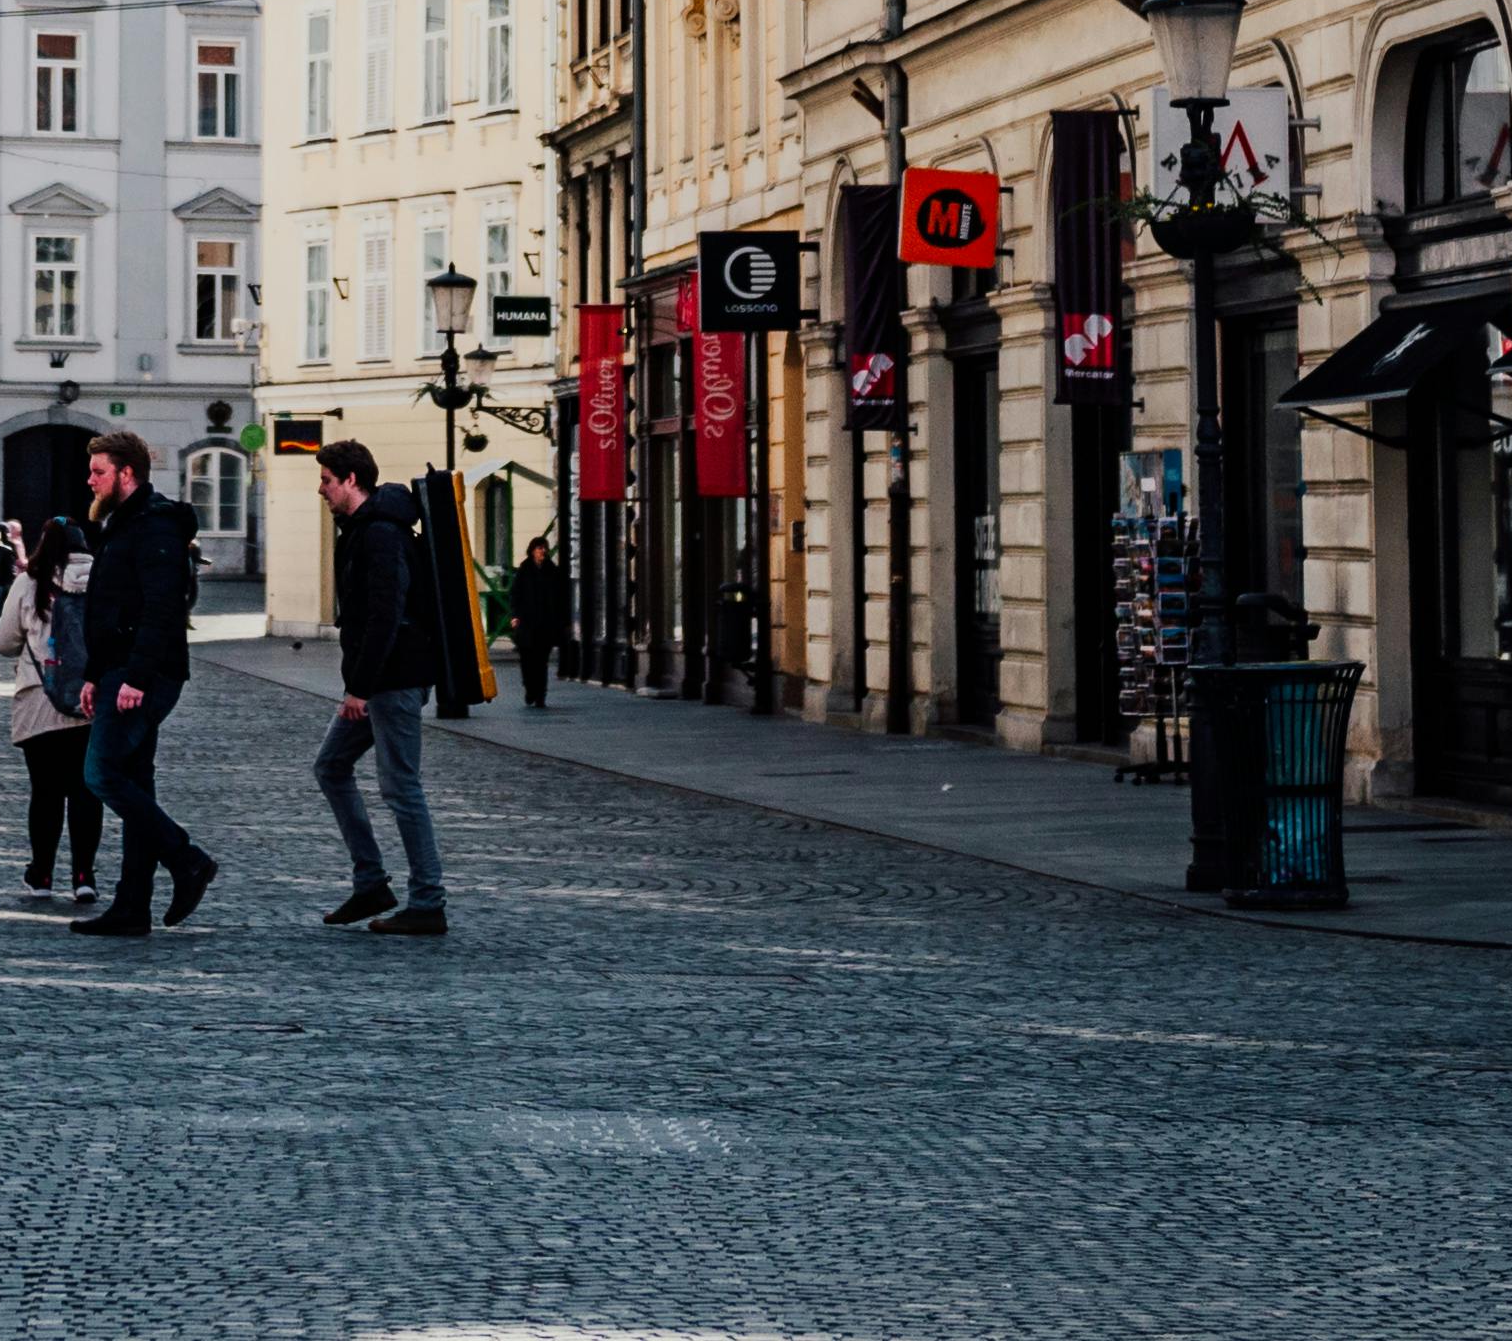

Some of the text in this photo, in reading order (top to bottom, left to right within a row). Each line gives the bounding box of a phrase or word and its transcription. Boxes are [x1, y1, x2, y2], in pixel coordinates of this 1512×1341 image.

[927, 199, 960, 238] M
[959, 203, 973, 240] MINUTE
[496, 311, 548, 322] HUMANA
[1064, 367, 1115, 379] Mercator
[587, 357, 618, 450] s.Oliver
